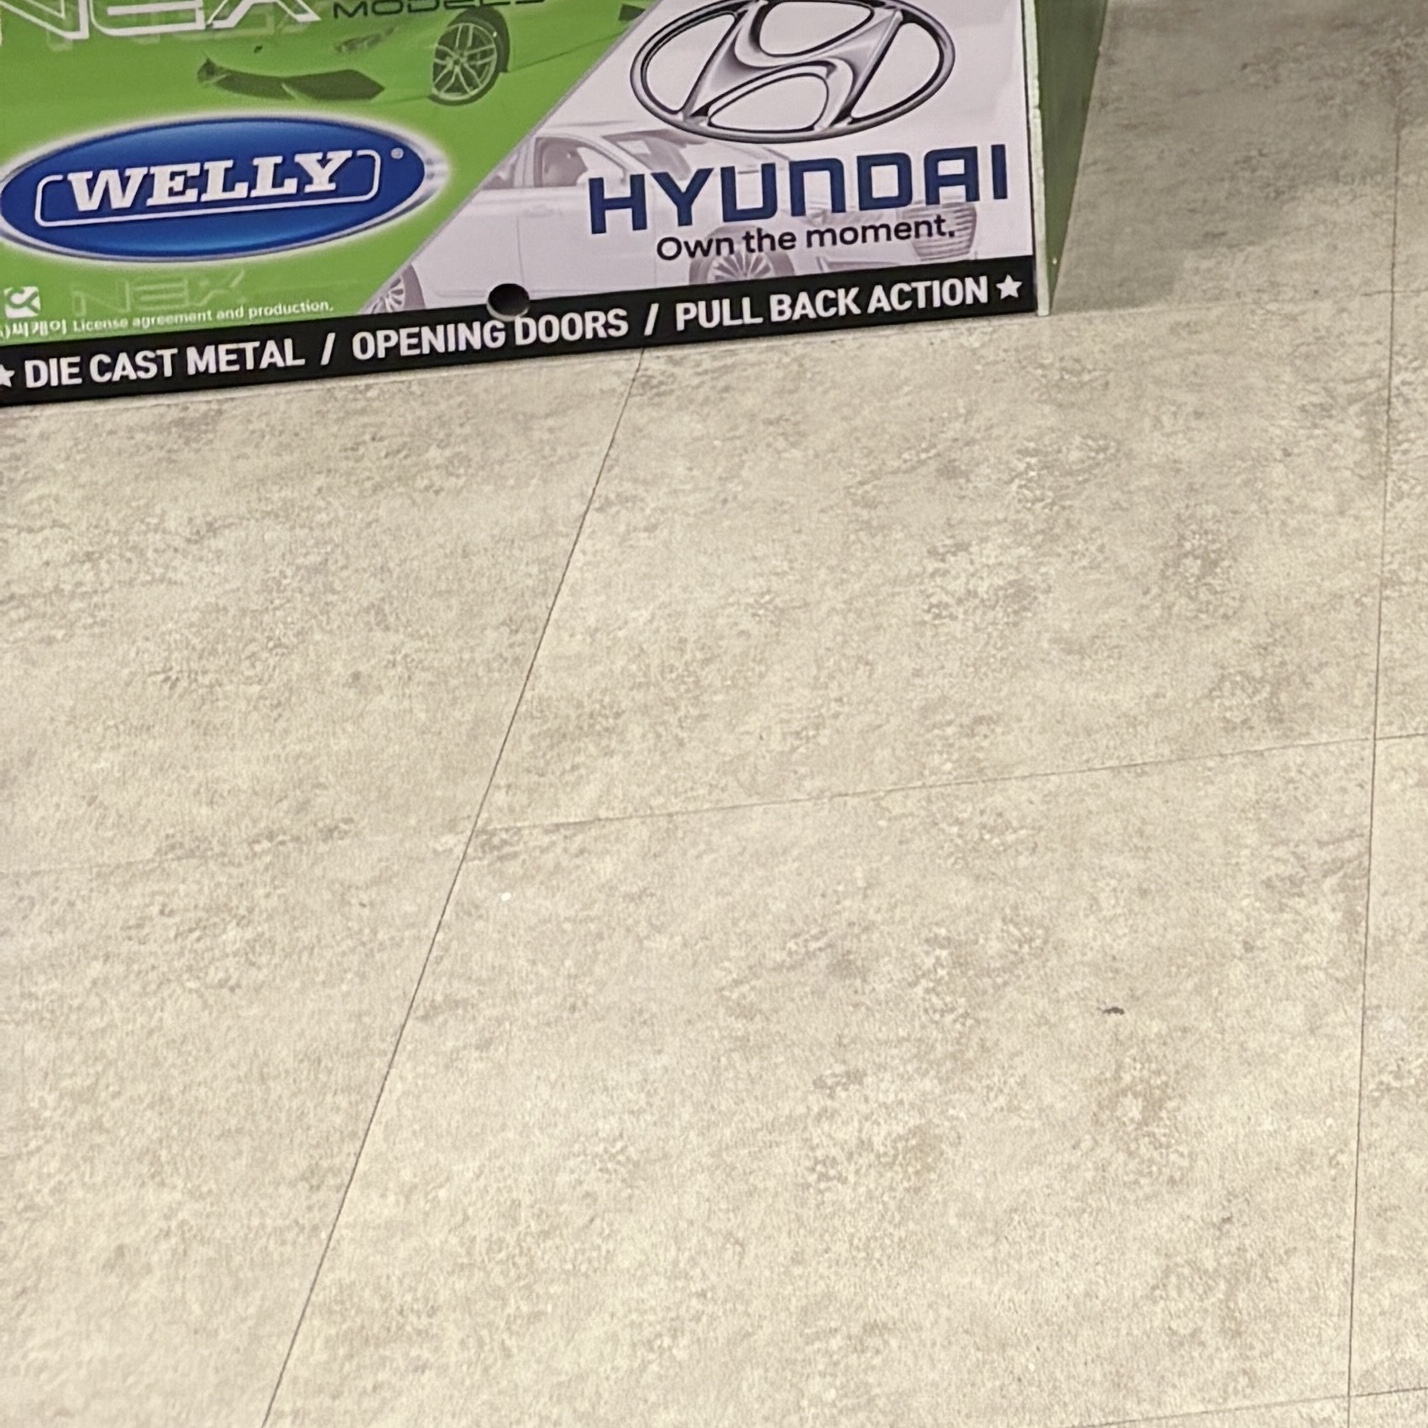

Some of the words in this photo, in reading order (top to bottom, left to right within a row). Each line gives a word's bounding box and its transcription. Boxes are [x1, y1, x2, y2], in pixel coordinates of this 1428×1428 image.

[67, 150, 353, 212] WELLY
[589, 144, 1008, 235] HYUNDAI
[657, 236, 735, 261] Own
[741, 227, 797, 254] the
[806, 215, 956, 249] moment.
[25, 357, 82, 388] DIE
[90, 349, 177, 383] CAST
[187, 338, 305, 375] METAL
[352, 322, 504, 361] OPENING
[515, 309, 629, 346] DOORS
[676, 298, 763, 332] PULL
[770, 286, 861, 323] BACK
[868, 276, 989, 314] ACTION
[73, 317, 128, 332] License
[131, 310, 213, 330] agreement
[216, 306, 245, 321] and
[248, 300, 334, 320] production.
